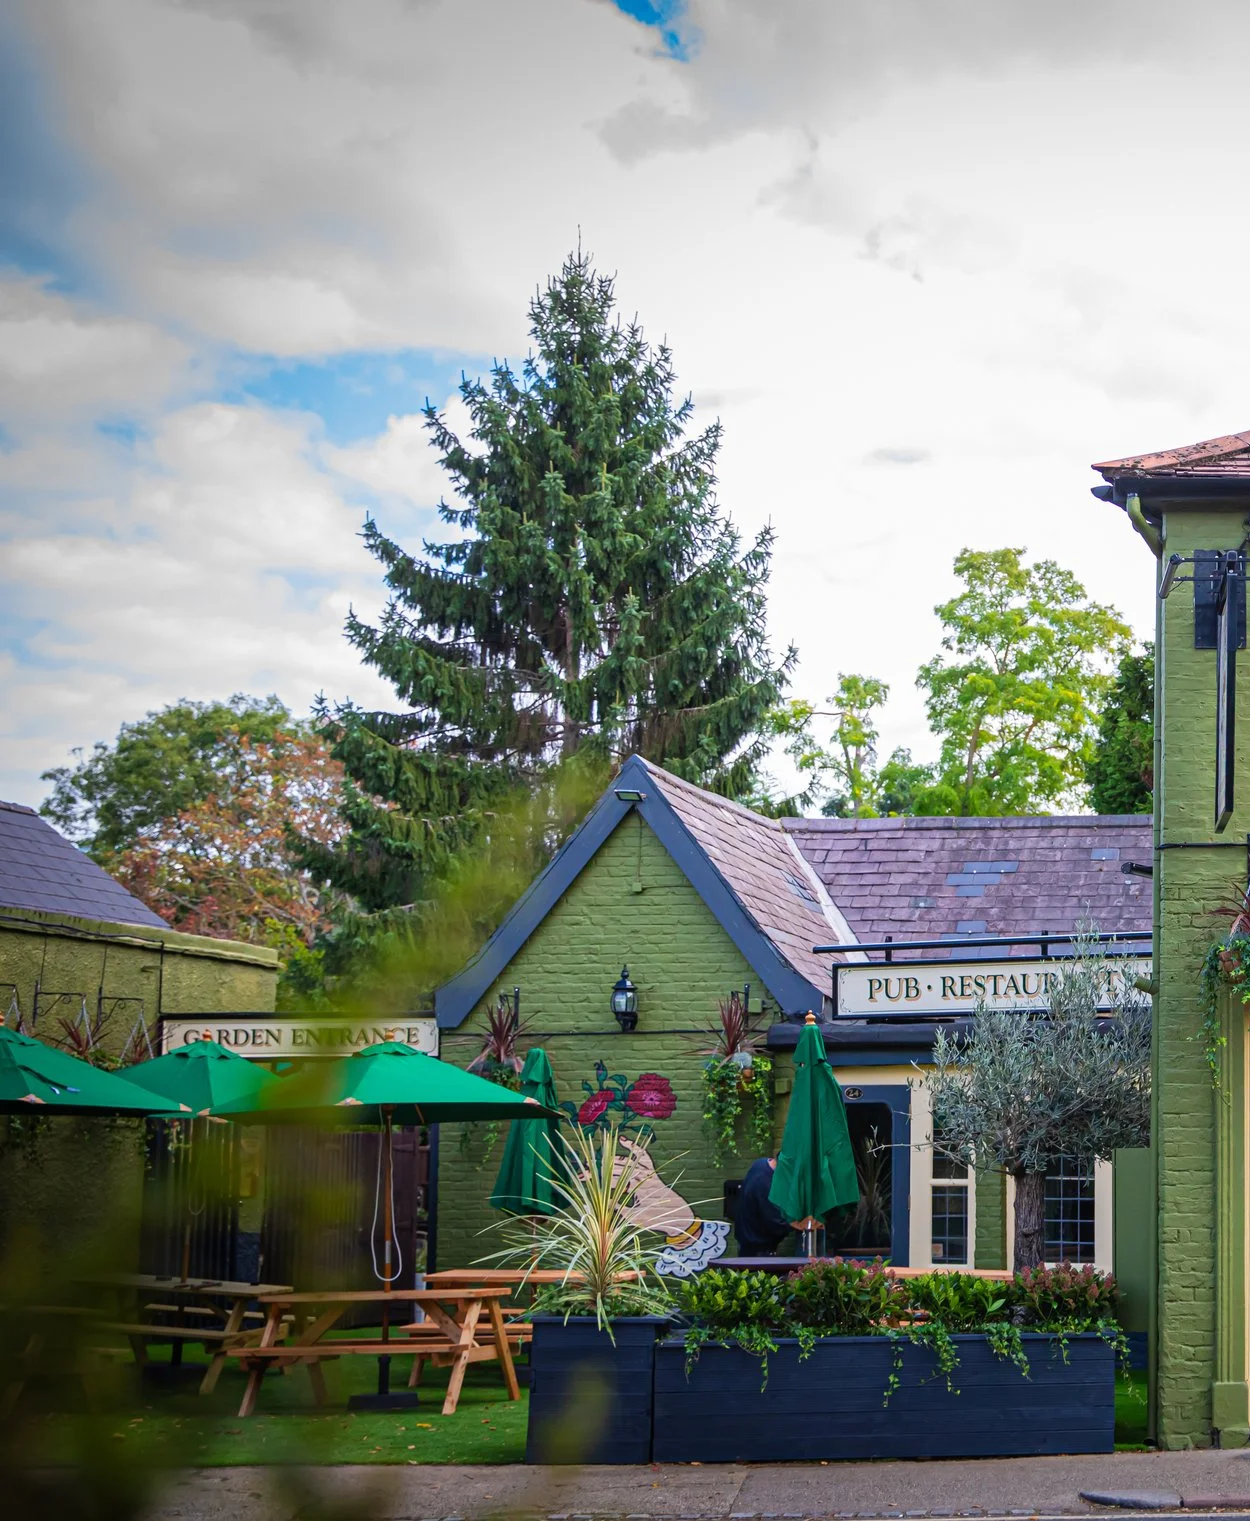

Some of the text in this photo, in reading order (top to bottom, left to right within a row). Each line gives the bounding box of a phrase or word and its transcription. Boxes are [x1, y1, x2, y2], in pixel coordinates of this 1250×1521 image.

[867, 975, 922, 1002] PUB
[941, 970, 1119, 1000] RESTAURT
[183, 1028, 283, 1047] GRDEN
